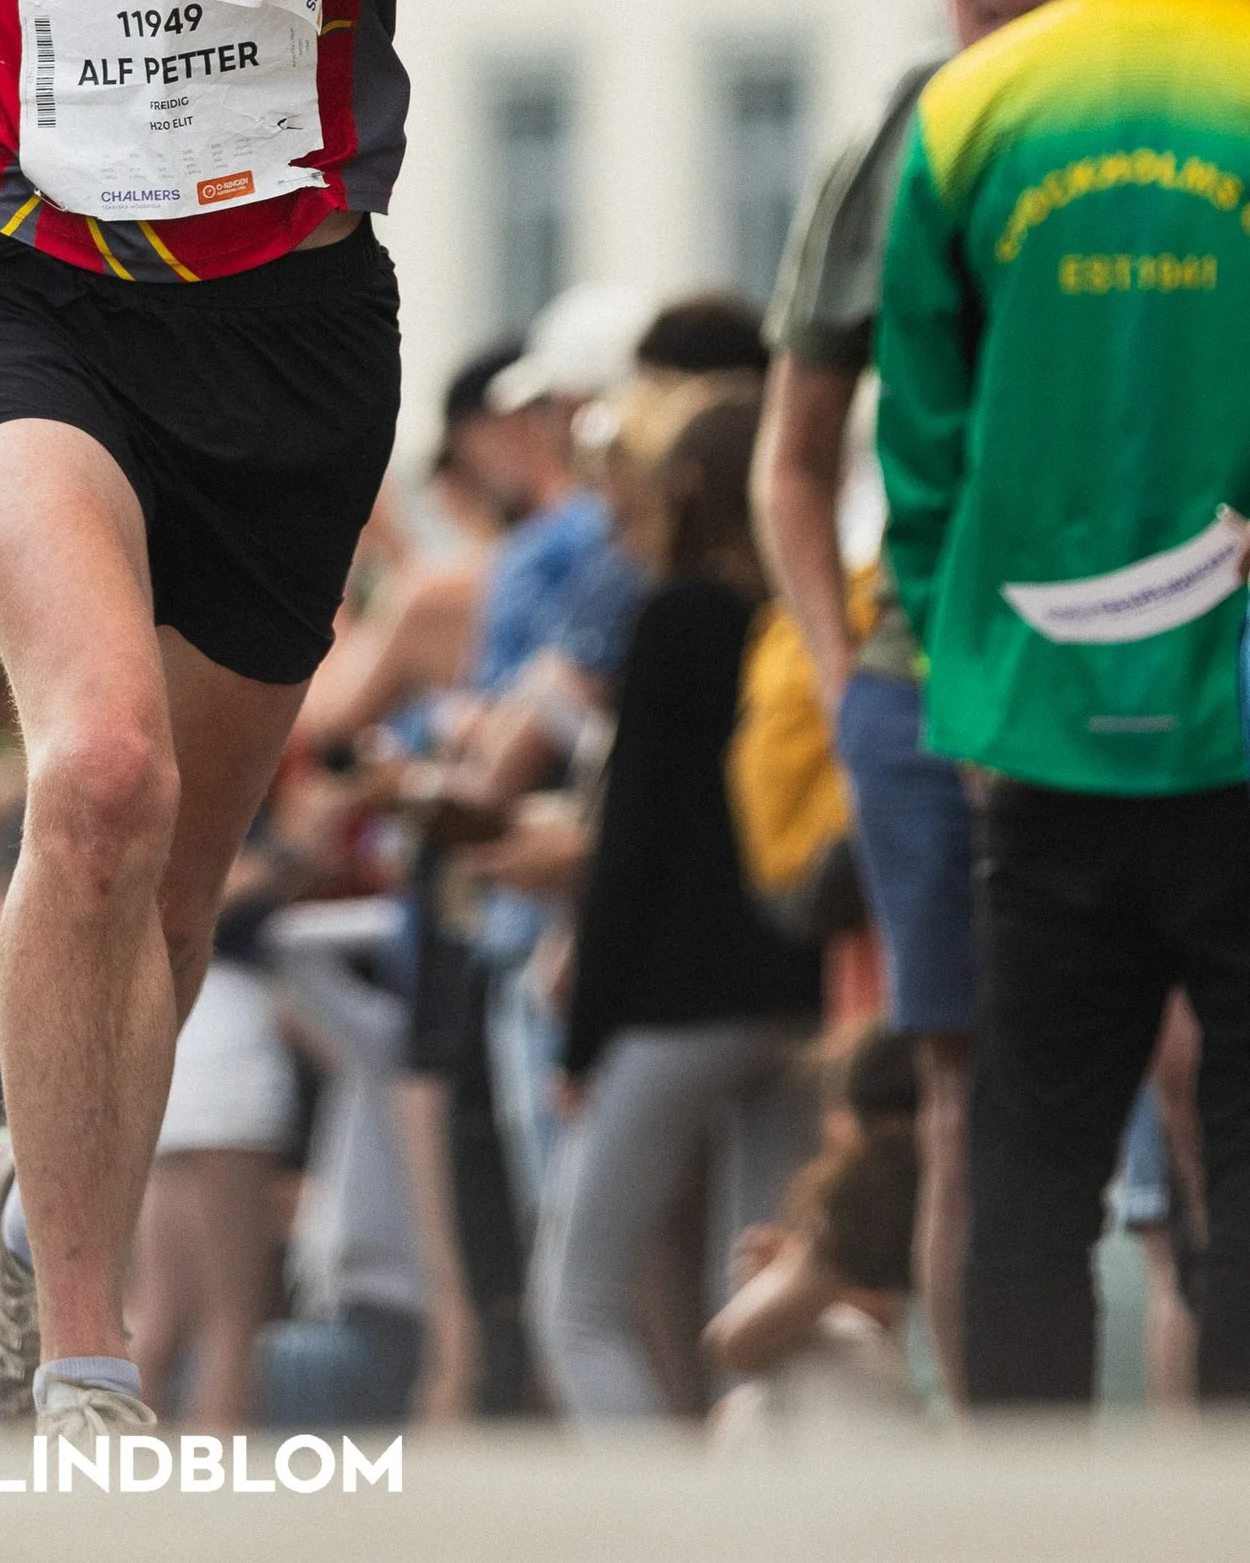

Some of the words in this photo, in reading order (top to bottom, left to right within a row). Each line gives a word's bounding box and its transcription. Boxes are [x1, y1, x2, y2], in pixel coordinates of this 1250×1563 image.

[116, 3, 203, 38] 11949
[78, 57, 134, 86] ALF
[144, 41, 260, 85] PETTER
[150, 96, 190, 110] FREIDIG
[172, 115, 194, 129] ELIT
[101, 189, 181, 203] CHALMERS
